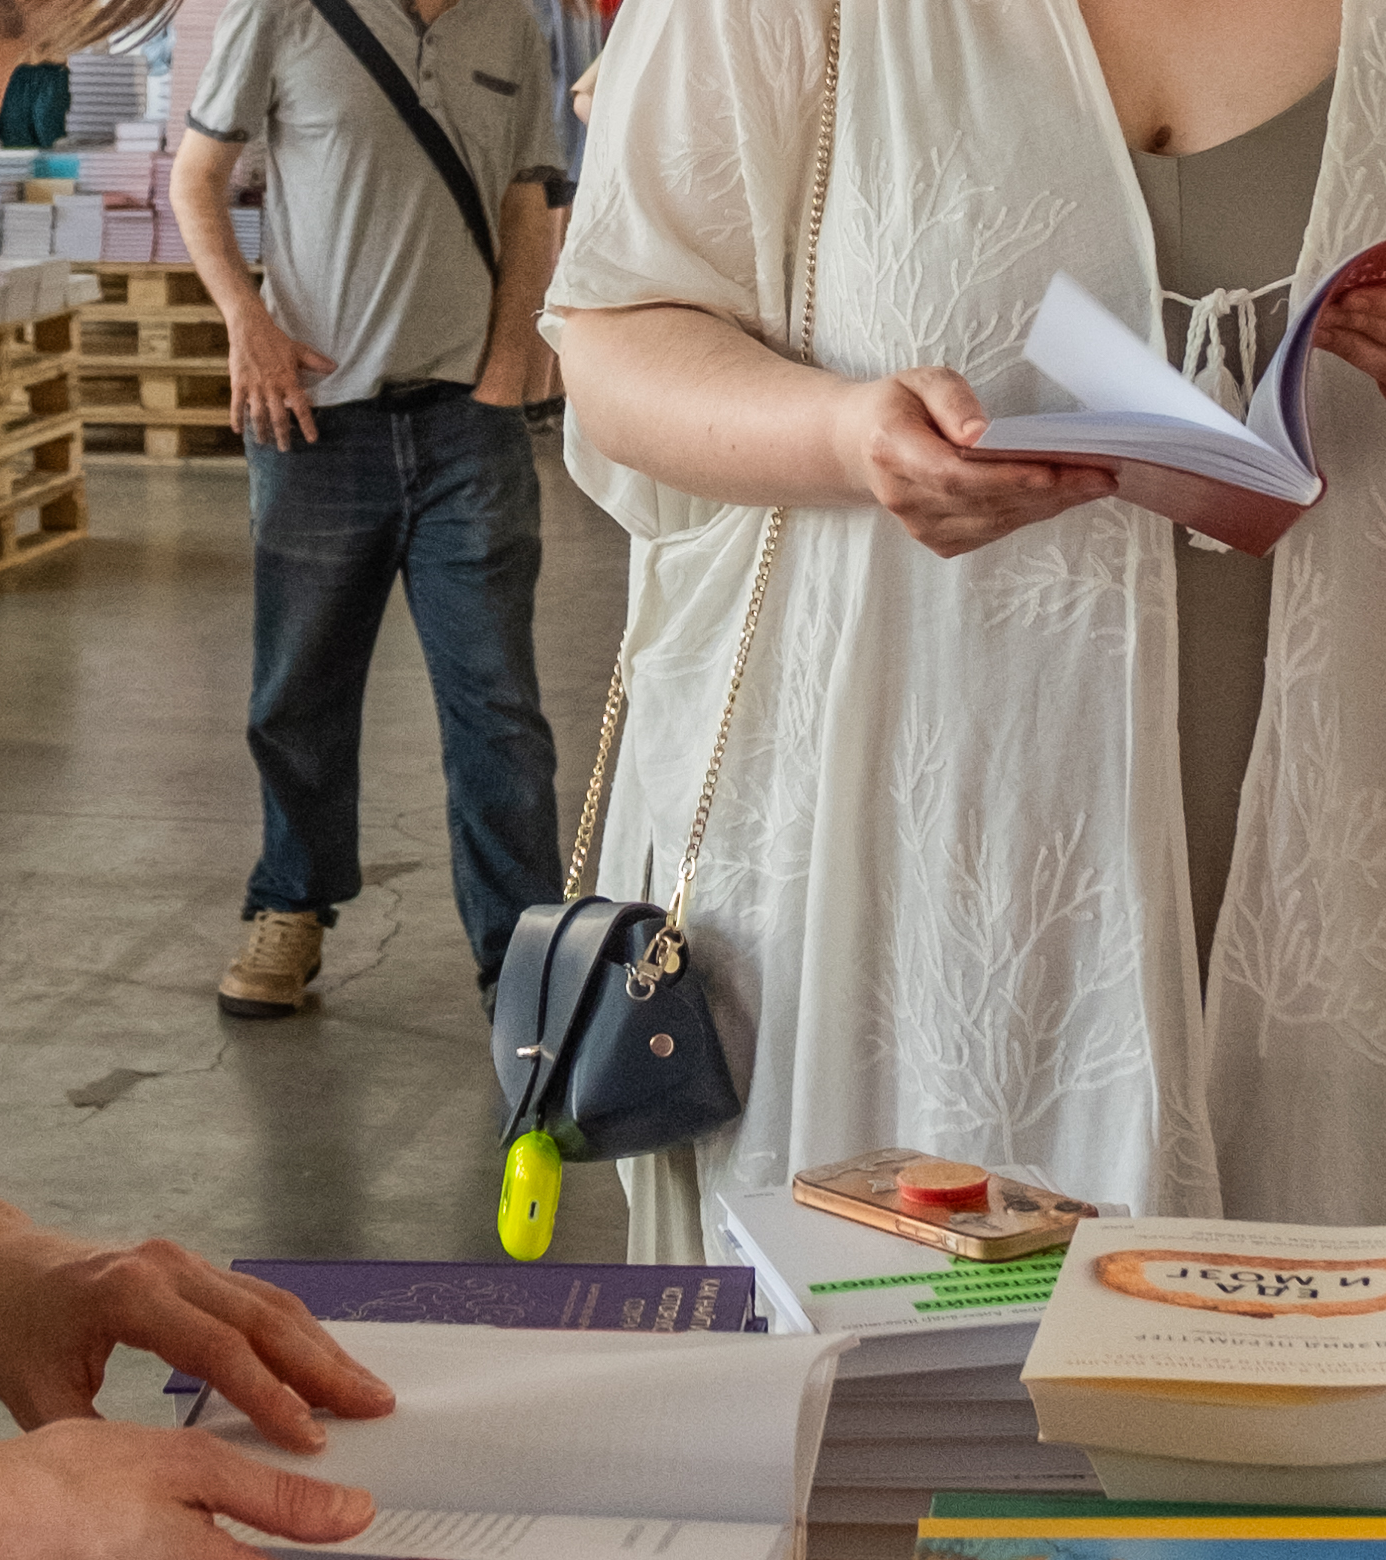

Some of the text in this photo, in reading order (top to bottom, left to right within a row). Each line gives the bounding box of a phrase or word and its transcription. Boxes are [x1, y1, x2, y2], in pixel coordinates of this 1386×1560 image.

[1163, 1267, 1370, 1288] И МОЗГ
[1212, 1282, 1319, 1299] ЕДА
